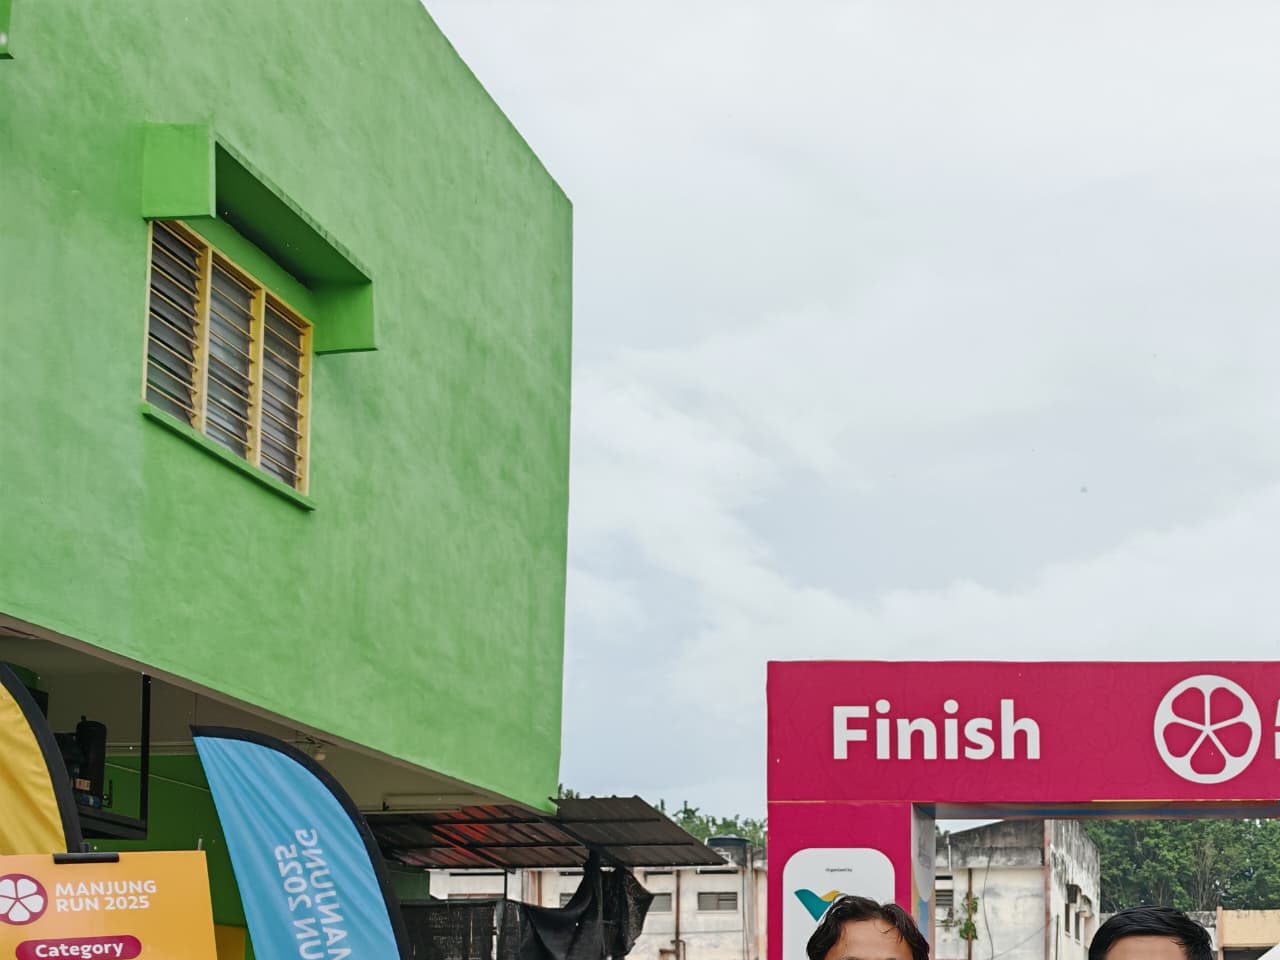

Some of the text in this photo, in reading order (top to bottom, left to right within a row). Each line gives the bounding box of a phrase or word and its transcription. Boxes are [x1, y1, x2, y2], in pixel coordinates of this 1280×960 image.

[832, 698, 1041, 760] Finish
[55, 880, 157, 897] MANJUNG
[56, 895, 150, 912] RUN 2025
[35, 942, 124, 959] Category
